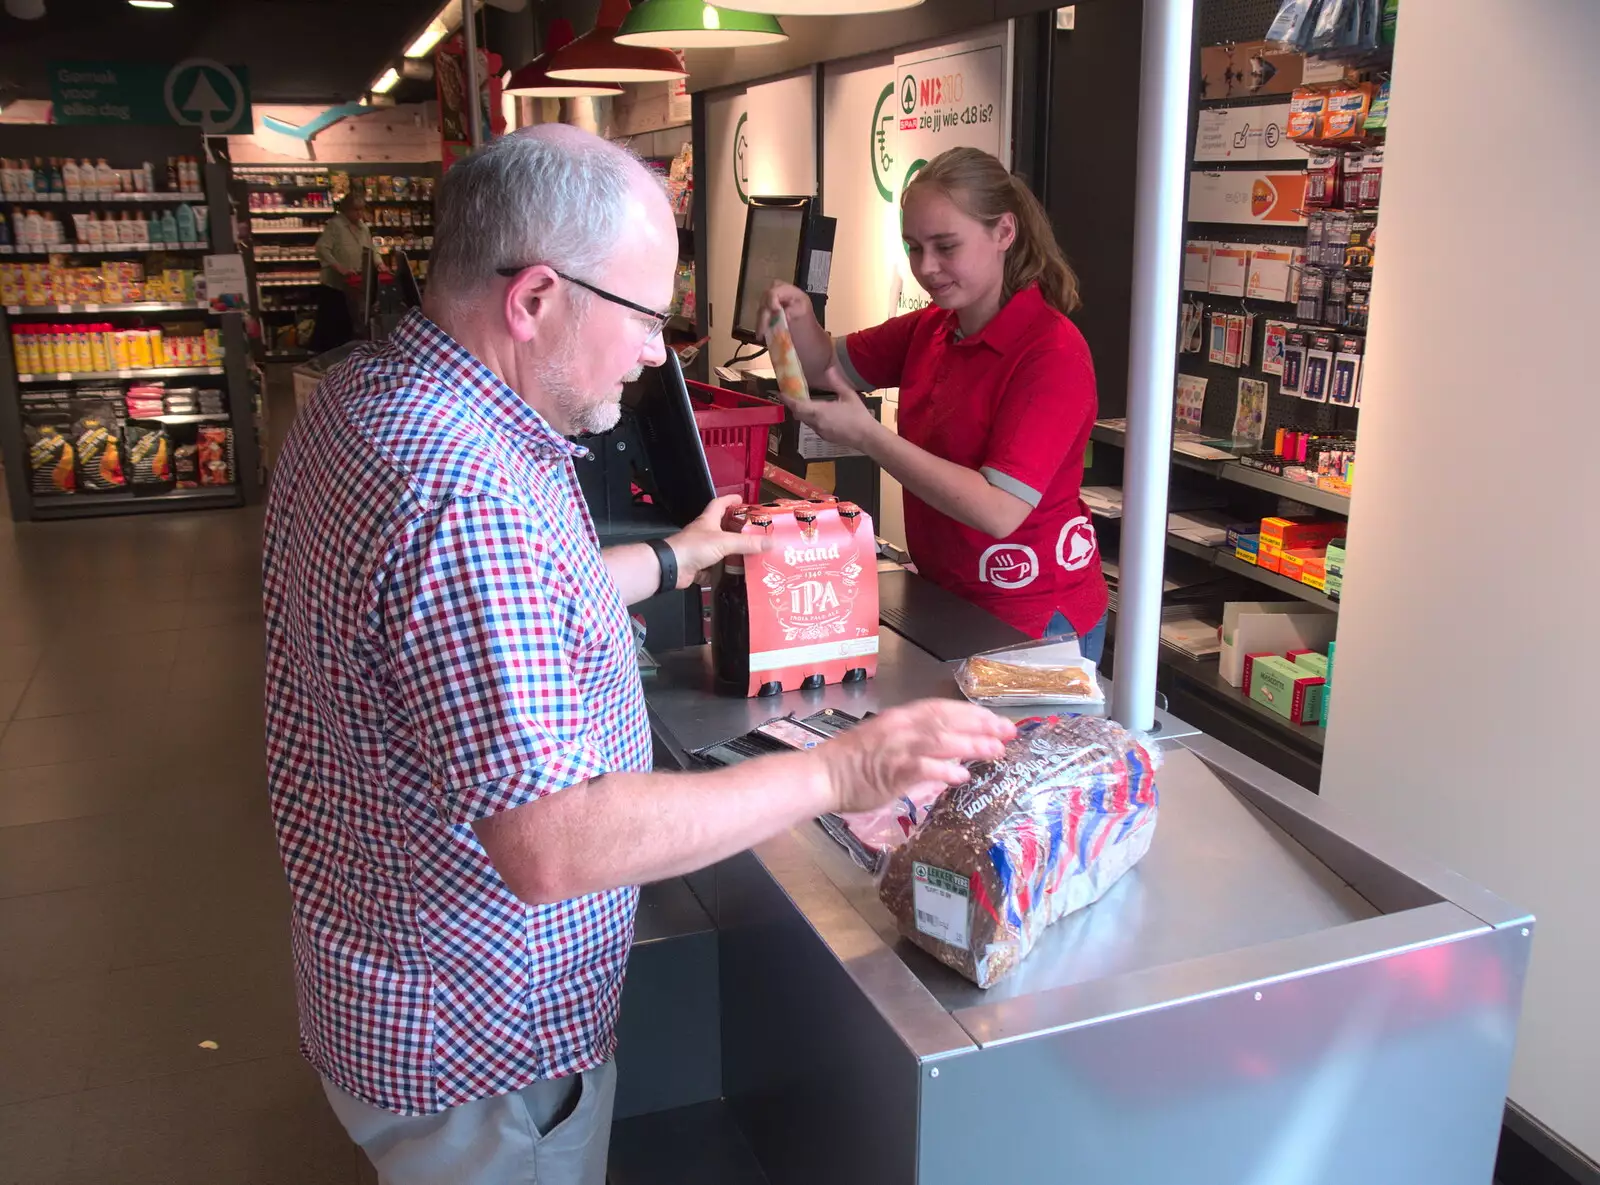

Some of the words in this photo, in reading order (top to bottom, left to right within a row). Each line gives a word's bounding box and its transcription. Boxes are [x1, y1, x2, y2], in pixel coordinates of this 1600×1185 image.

[60, 88, 99, 100] voor
[63, 102, 97, 116] elke
[100, 102, 131, 120] dag
[919, 111, 932, 129] zie
[932, 108, 942, 133] jij
[943, 107, 959, 127] wie
[960, 105, 978, 125] <18
[979, 103, 994, 123] is?
[900, 119, 917, 130] SPAR
[784, 543, 840, 566] Brand
[787, 581, 840, 614] IPA
[963, 793, 993, 819] van
[991, 773, 1018, 798] der
